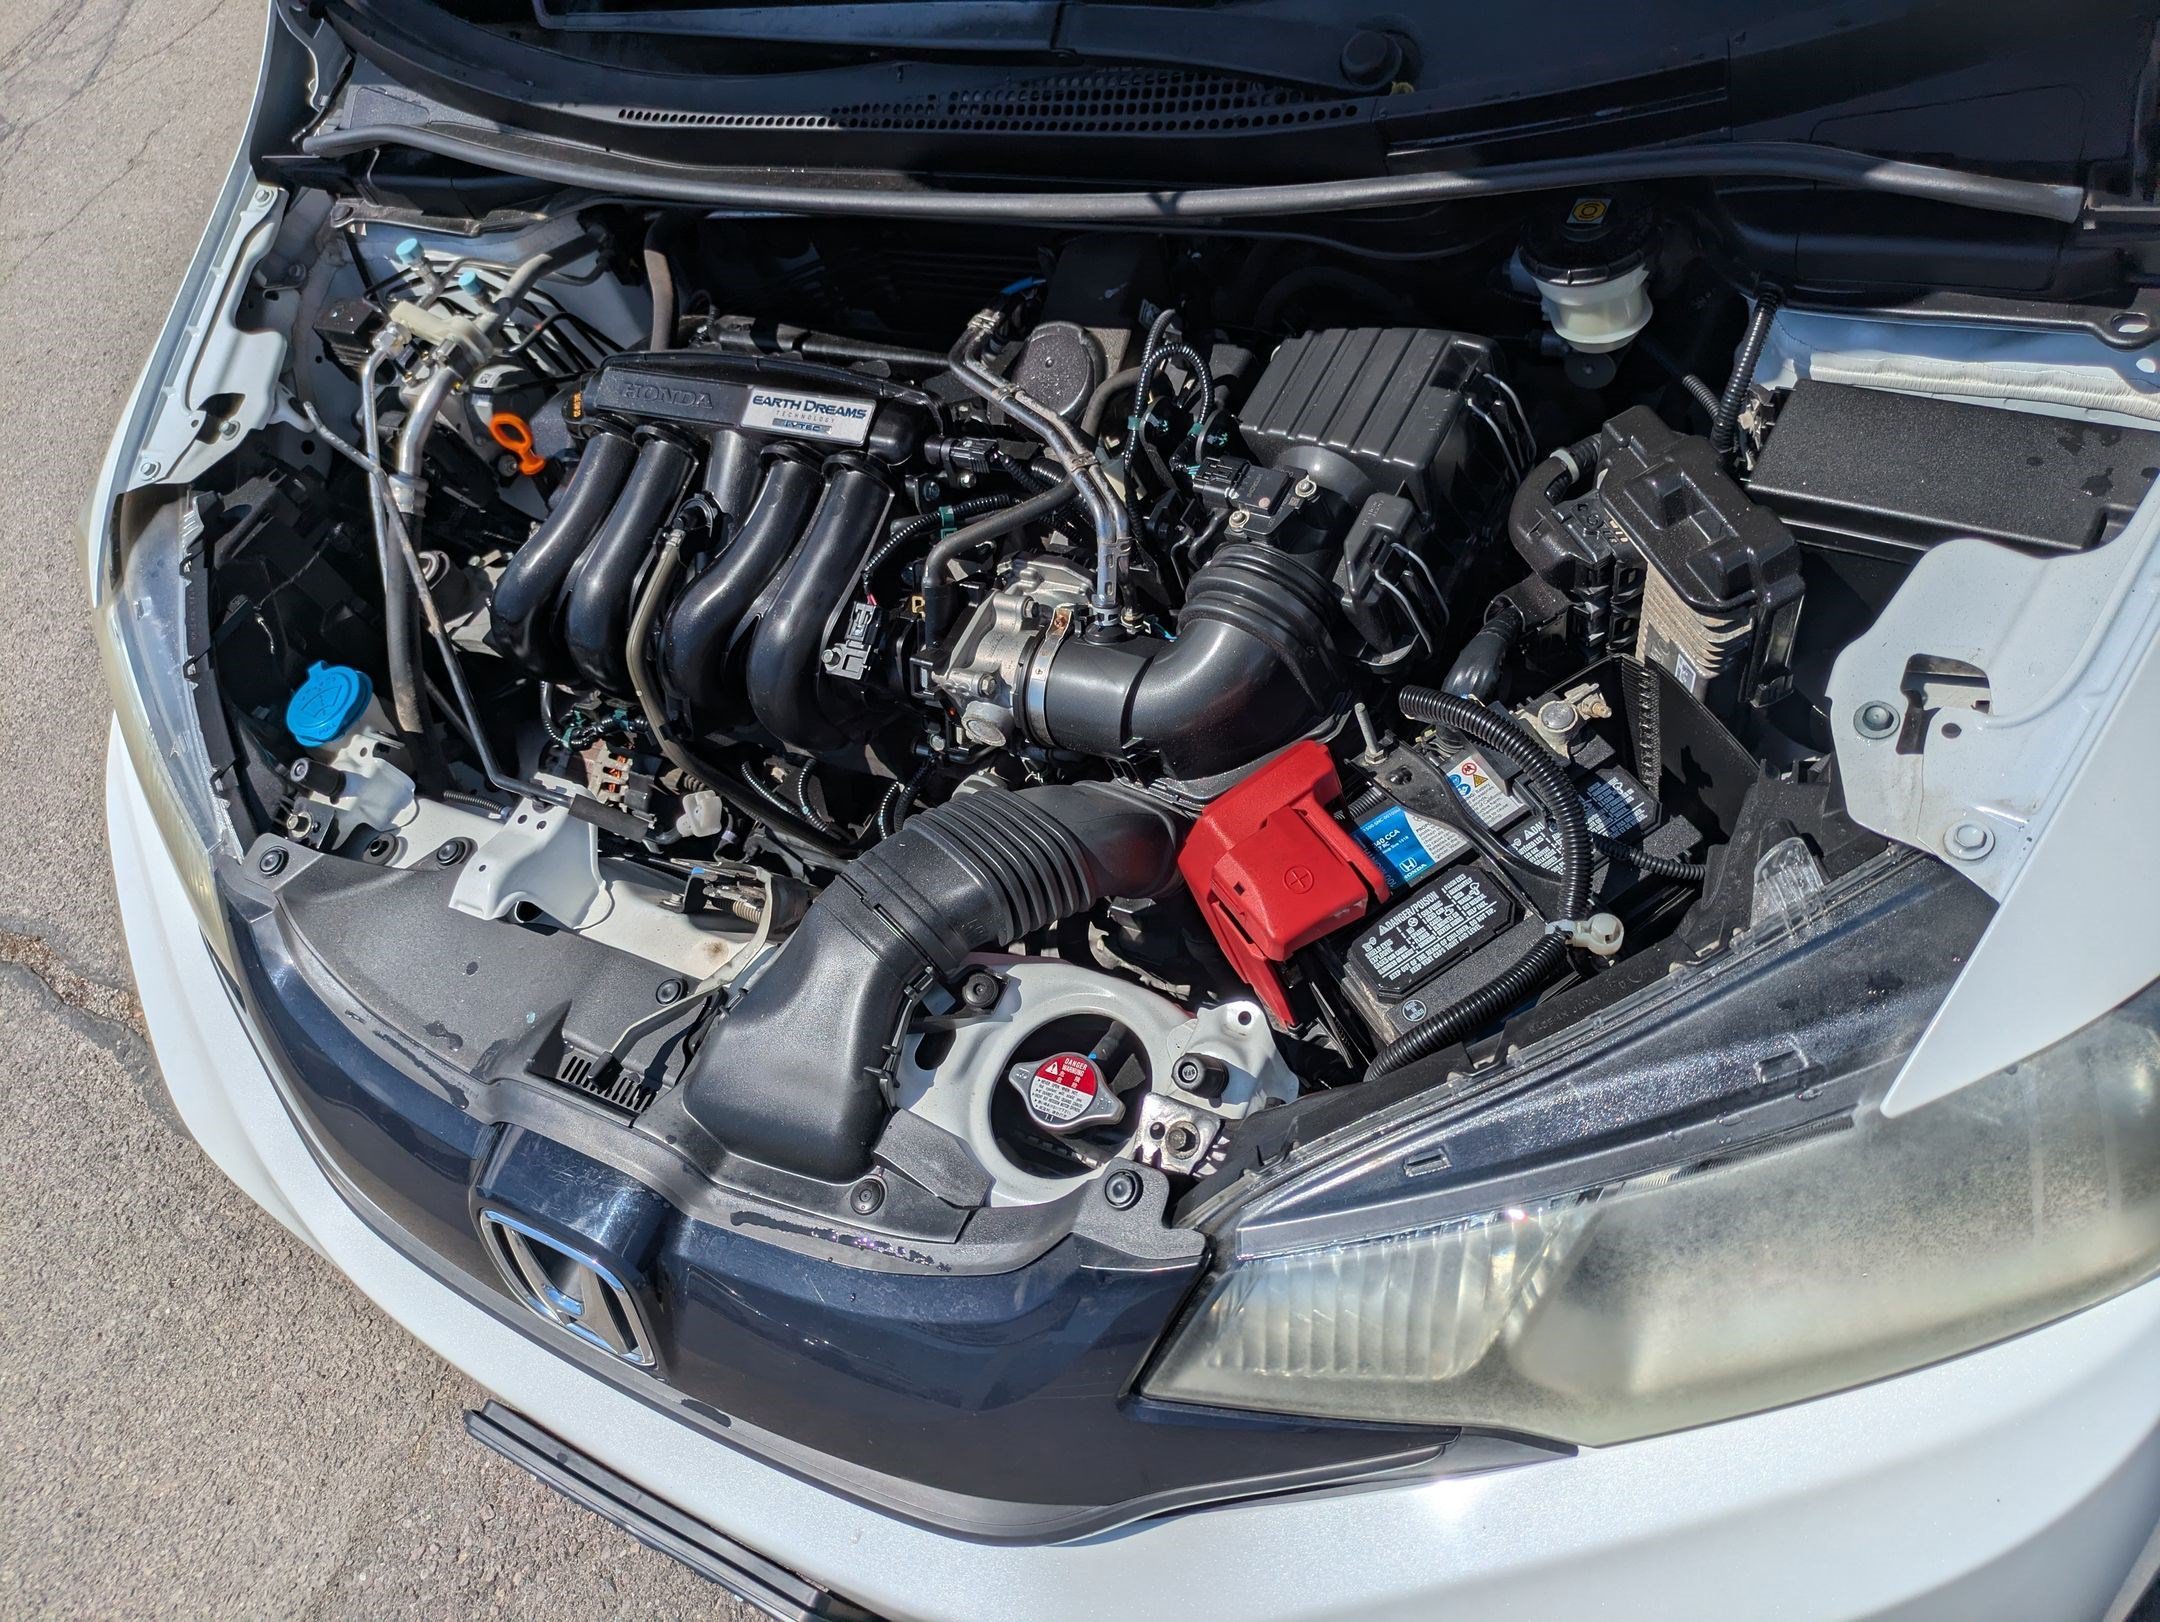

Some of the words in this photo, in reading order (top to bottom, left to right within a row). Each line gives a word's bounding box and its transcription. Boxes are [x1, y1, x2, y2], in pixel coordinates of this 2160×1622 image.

[624, 383, 713, 409] HONDA
[753, 395, 801, 410] EARTH
[804, 400, 867, 419] DREAMS
[776, 410, 835, 423] TECHNOLOGY
[1383, 827, 1400, 841] CCA
[1384, 890, 1439, 930] DANGER/POISON
[1063, 1057, 1088, 1071] DANGER
